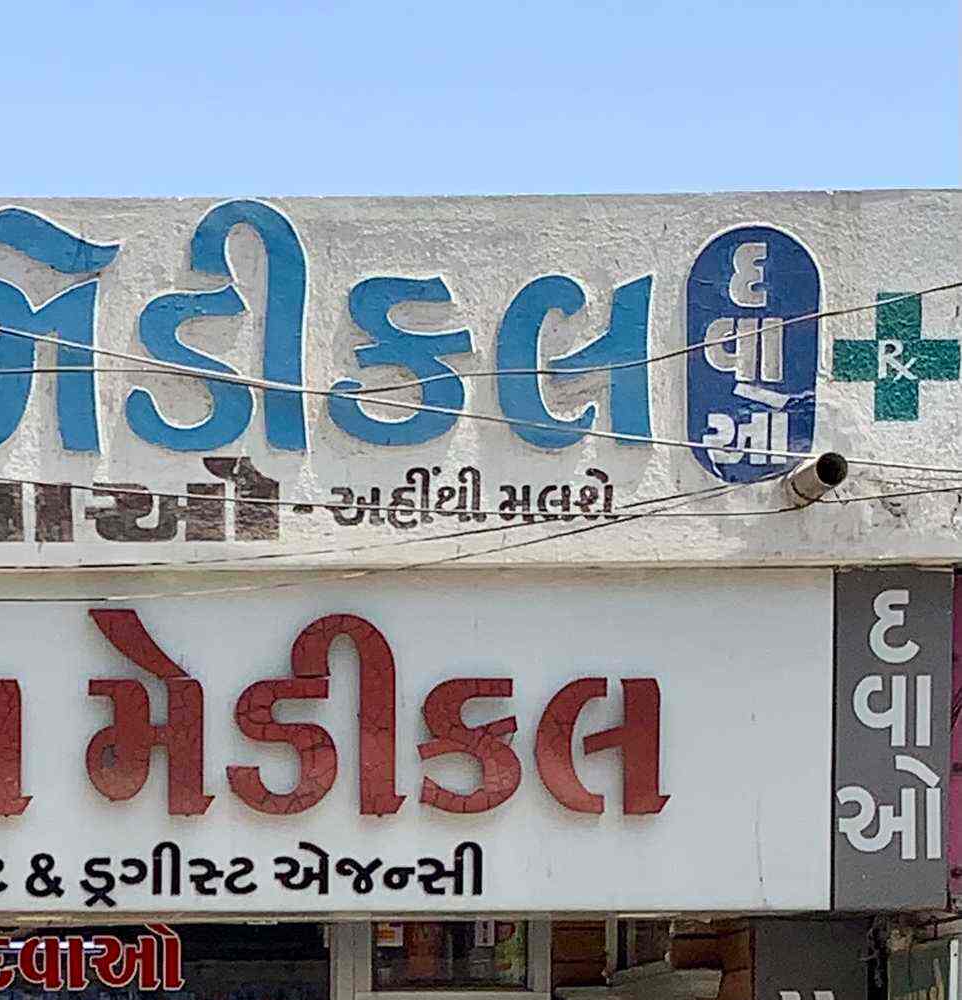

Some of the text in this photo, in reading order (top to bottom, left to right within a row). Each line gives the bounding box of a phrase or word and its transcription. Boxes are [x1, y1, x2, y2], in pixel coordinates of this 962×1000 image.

[701, 241, 816, 466] દવાઓ
[497, 467, 614, 522] મલશે
[85, 608, 671, 817] મેડીકલ
[838, 589, 942, 861] દવાઓ
[24, 854, 65, 897] &
[80, 841, 258, 908] ડ્રગીસ્ટ
[273, 841, 484, 897] એજન્સી
